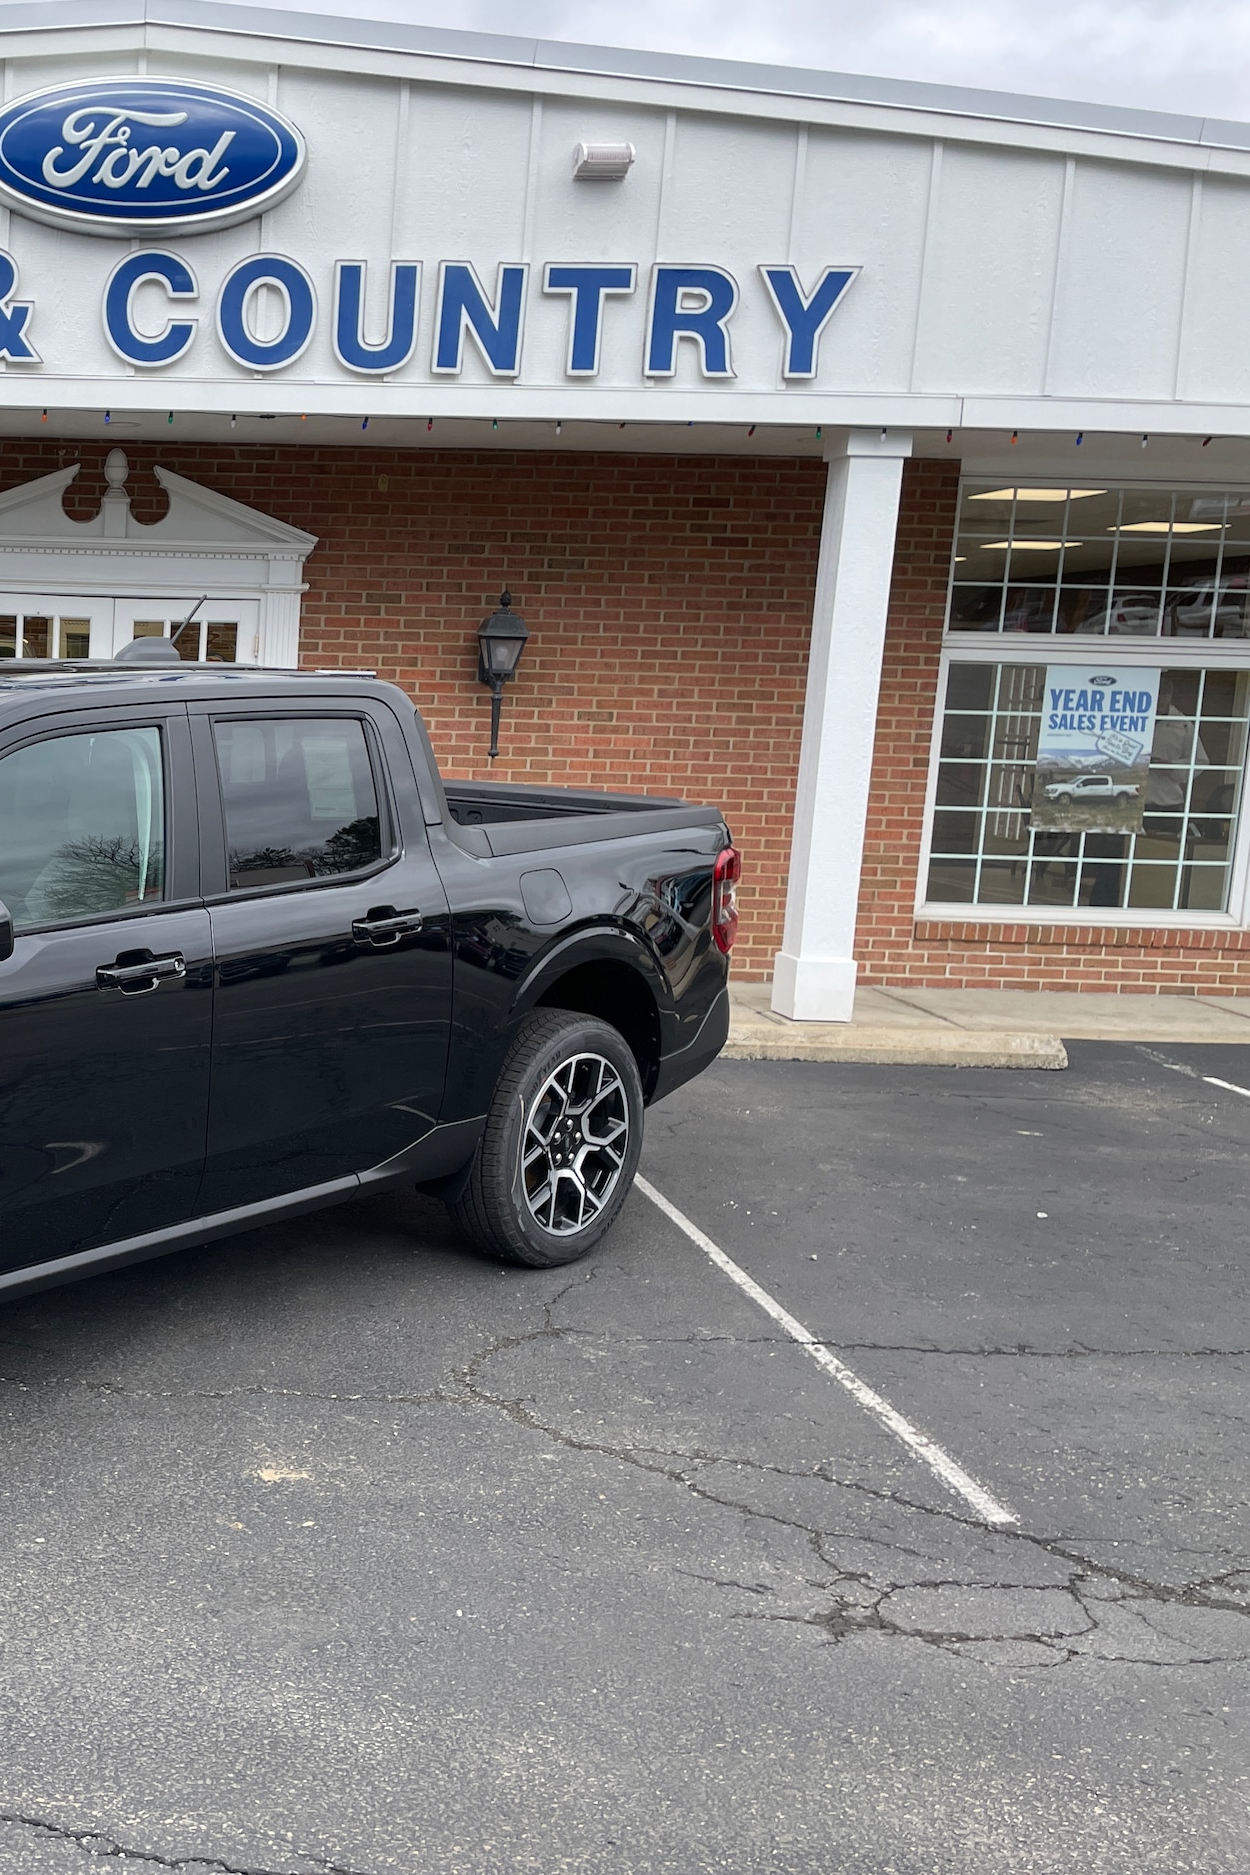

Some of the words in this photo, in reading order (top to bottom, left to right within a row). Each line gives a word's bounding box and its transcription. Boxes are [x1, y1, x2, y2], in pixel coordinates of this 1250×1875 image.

[42, 106, 237, 191] Ford
[102, 248, 863, 380] COUNTRY
[1092, 676, 1113, 686] Ford
[1050, 689, 1105, 713] YEAR
[1110, 691, 1152, 714] END
[1048, 713, 1096, 731] SALES
[1100, 715, 1149, 732] EVENT
